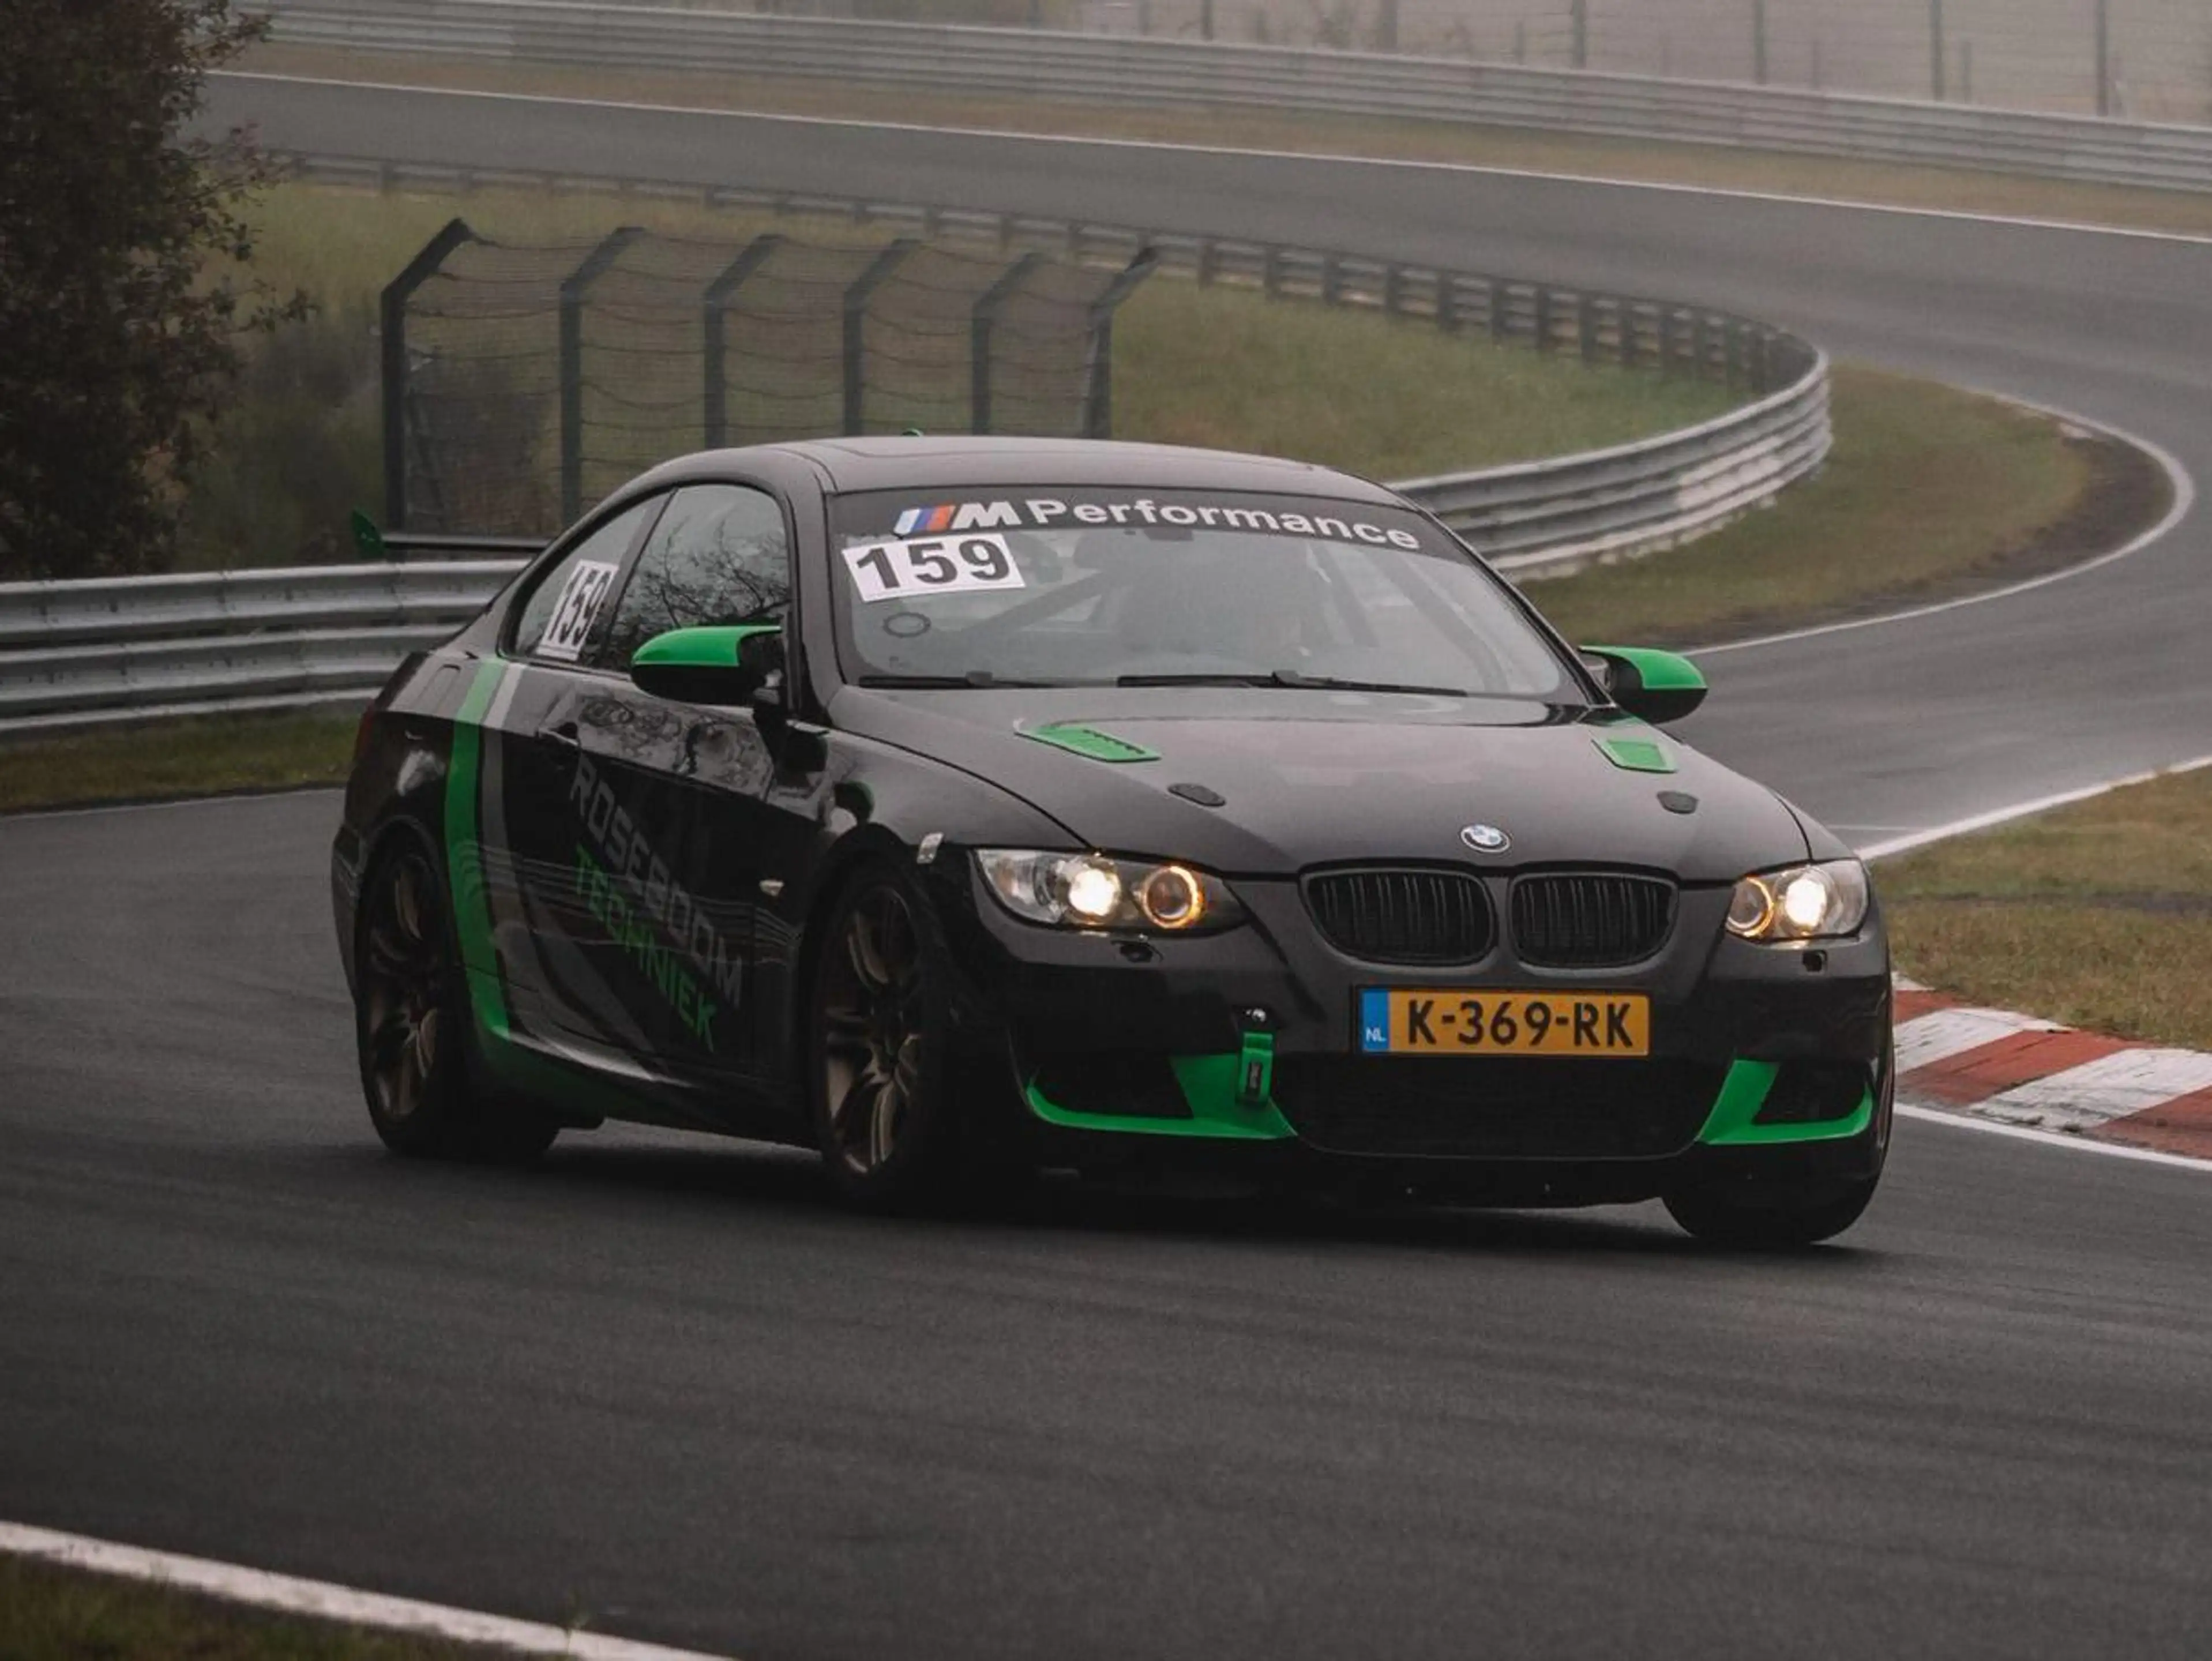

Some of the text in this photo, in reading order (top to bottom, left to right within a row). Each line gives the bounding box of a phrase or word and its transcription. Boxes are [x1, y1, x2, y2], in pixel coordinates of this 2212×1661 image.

[1024, 498, 1421, 551] Performance
[856, 539, 1011, 589] 159
[547, 564, 611, 646] 159
[569, 751, 742, 1010] ROSEBOOM
[1365, 999, 1633, 1047] NL K-369-RK
